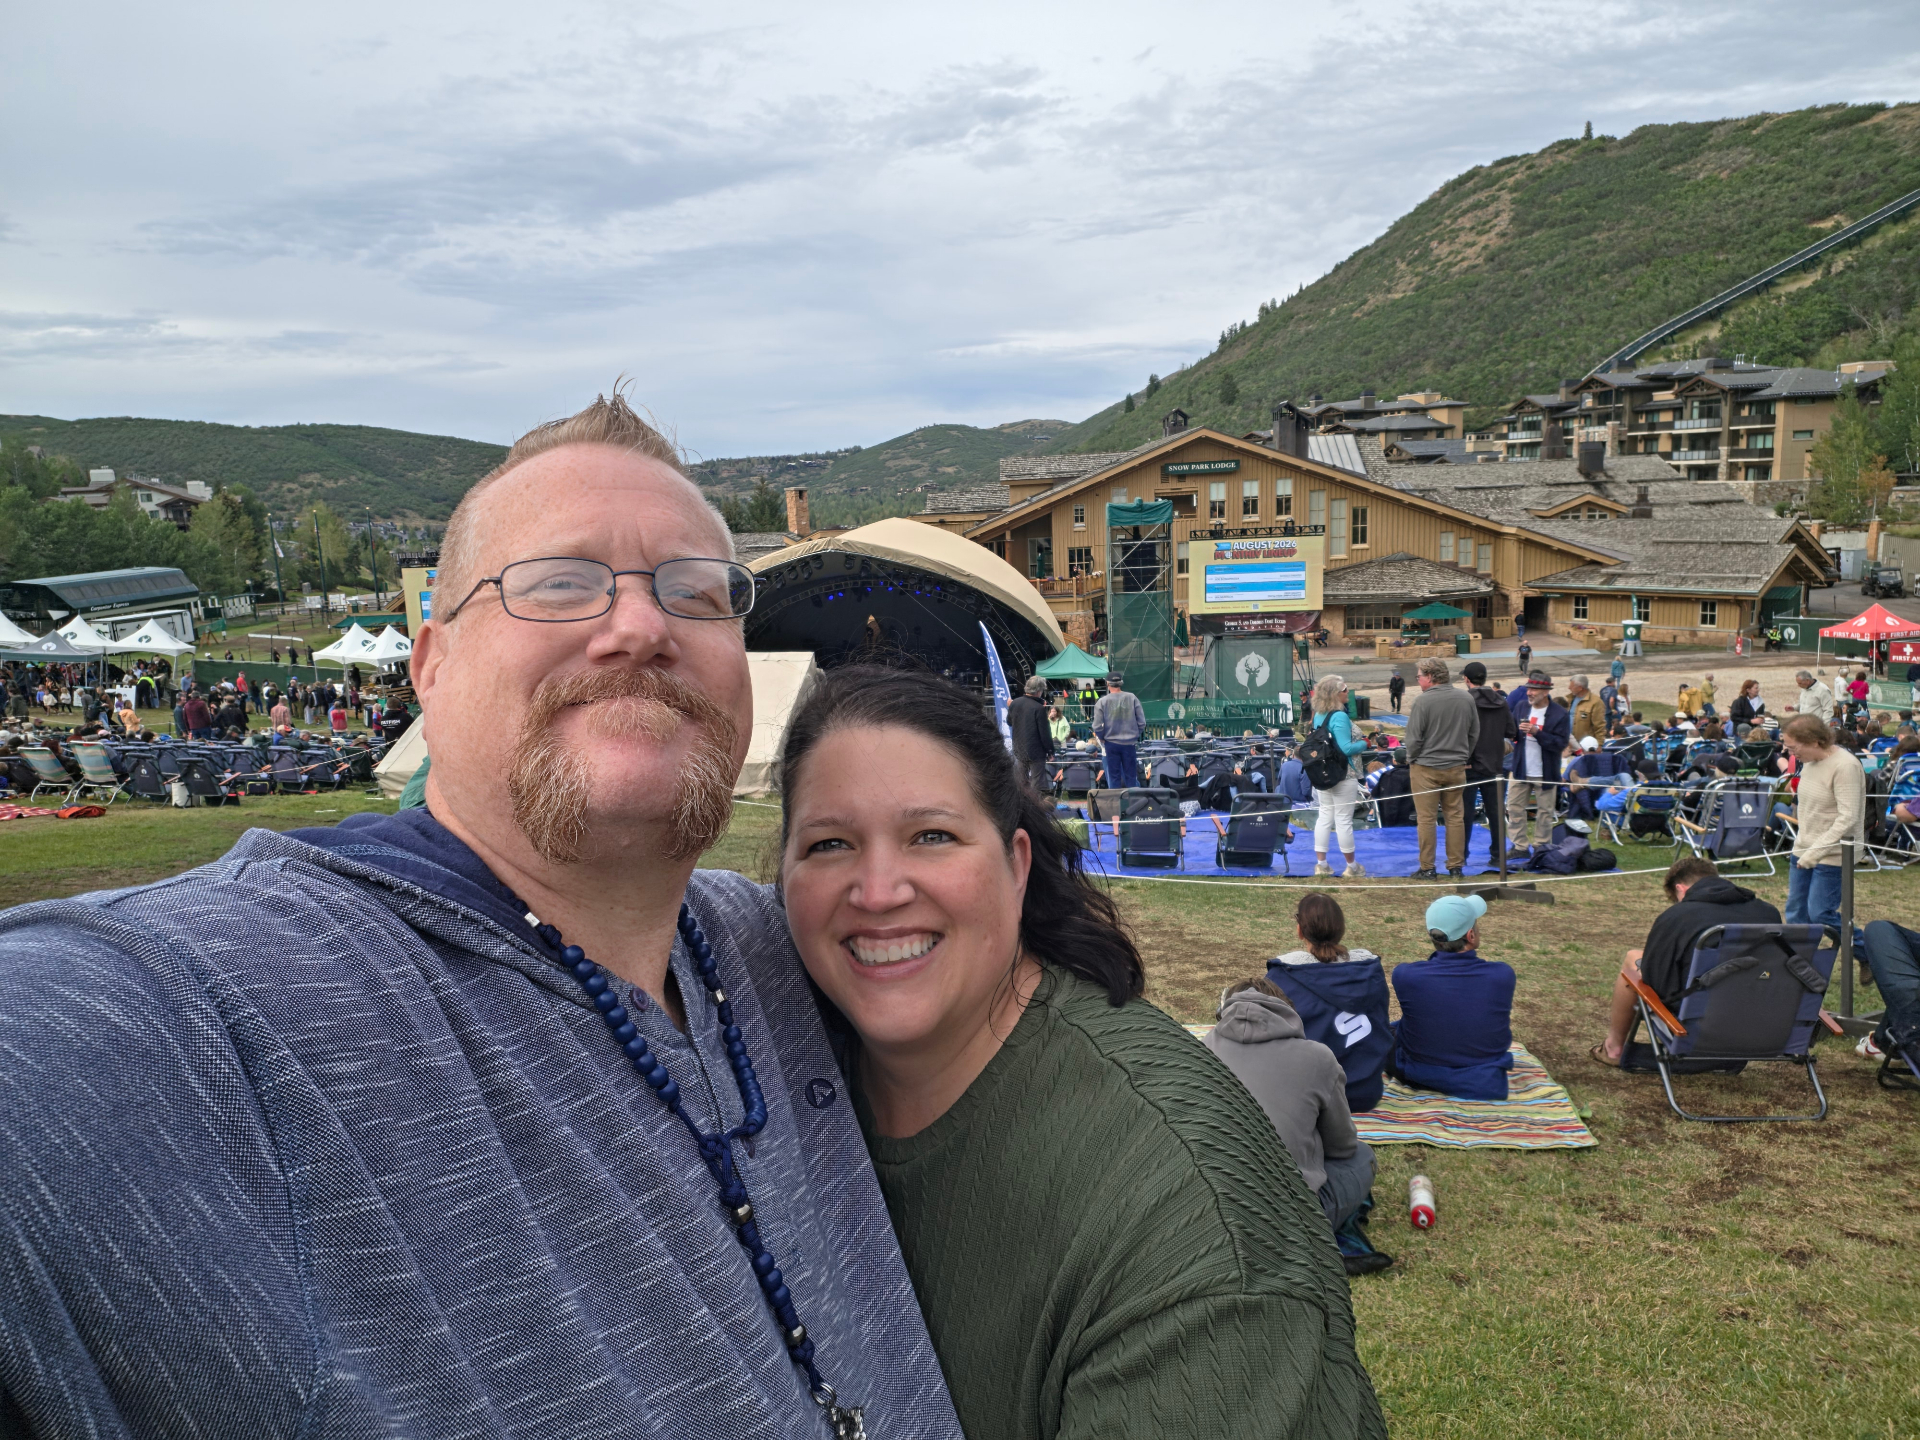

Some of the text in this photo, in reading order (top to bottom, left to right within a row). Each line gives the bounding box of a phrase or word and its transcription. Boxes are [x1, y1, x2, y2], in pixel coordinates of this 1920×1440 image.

[1232, 541, 1273, 550] AUGUST
[1273, 539, 1297, 549] 2026
[1262, 548, 1298, 558] LINEUP
